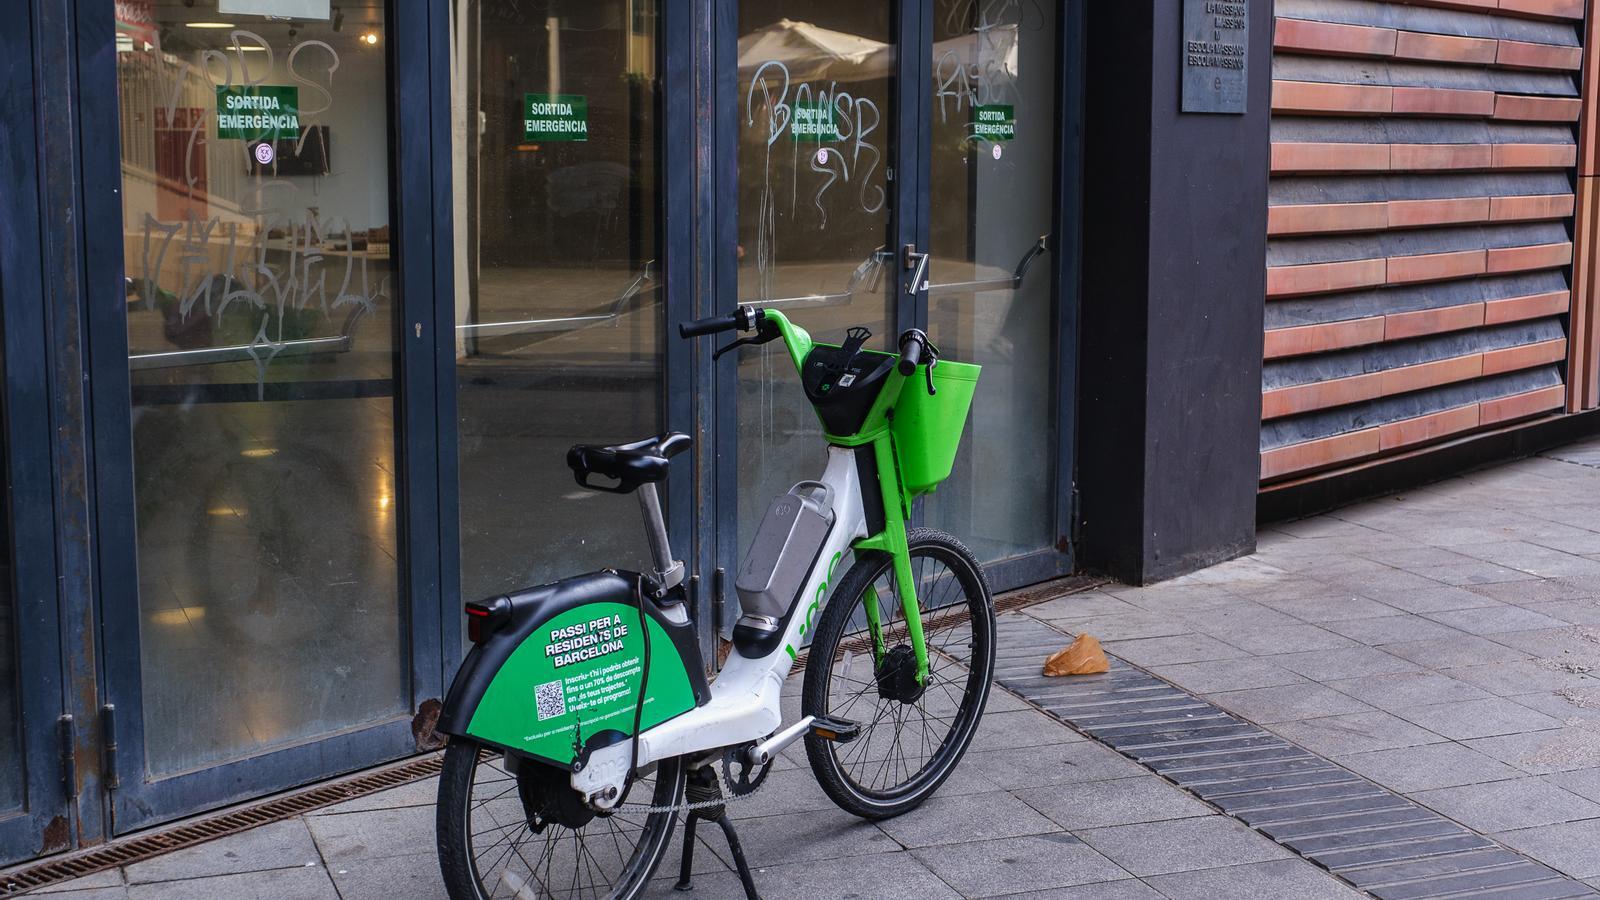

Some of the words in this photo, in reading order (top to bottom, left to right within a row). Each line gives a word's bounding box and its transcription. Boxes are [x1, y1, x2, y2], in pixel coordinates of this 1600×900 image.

[226, 95, 280, 110] SORTIDA
[532, 103, 573, 115] SORTIDA
[979, 111, 1005, 121] SORTIDA
[551, 623, 586, 642] PASSI
[589, 616, 611, 632] PER
[613, 614, 621, 625] A
[545, 630, 611, 656] RESIDENTS
[613, 625, 628, 638] DE
[554, 640, 624, 669] BARCELONA
[566, 686, 579, 694] fins
[585, 681, 593, 689] un
[593, 677, 605, 687] 70%
[613, 666, 641, 680] descompte
[567, 695, 576, 703] en
[587, 688, 600, 698] teus
